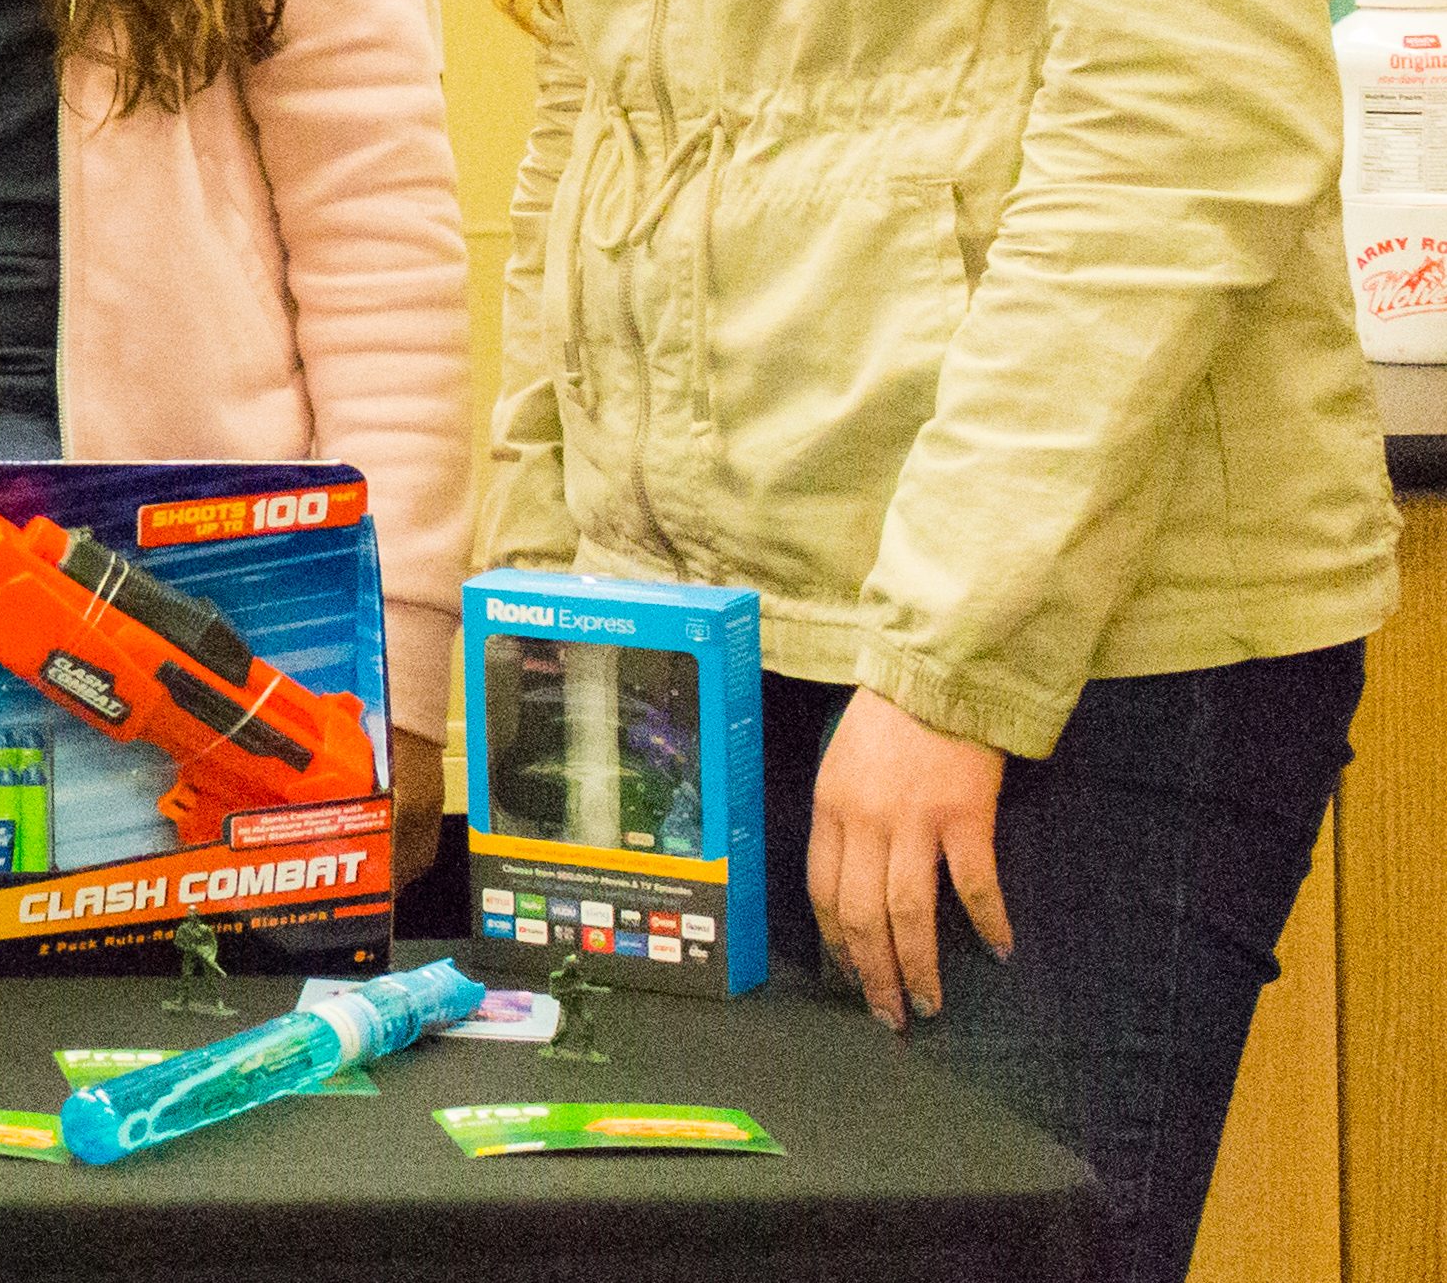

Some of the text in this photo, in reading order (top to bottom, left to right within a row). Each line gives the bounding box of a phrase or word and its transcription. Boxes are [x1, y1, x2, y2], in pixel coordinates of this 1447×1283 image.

[1356, 237, 1447, 270] ARMY RO
[151, 501, 247, 527] SHOOTS
[252, 492, 329, 530] 100
[195, 520, 245, 536] UP TO
[558, 609, 637, 635] Express
[19, 852, 368, 924] CLASH COMBAT
